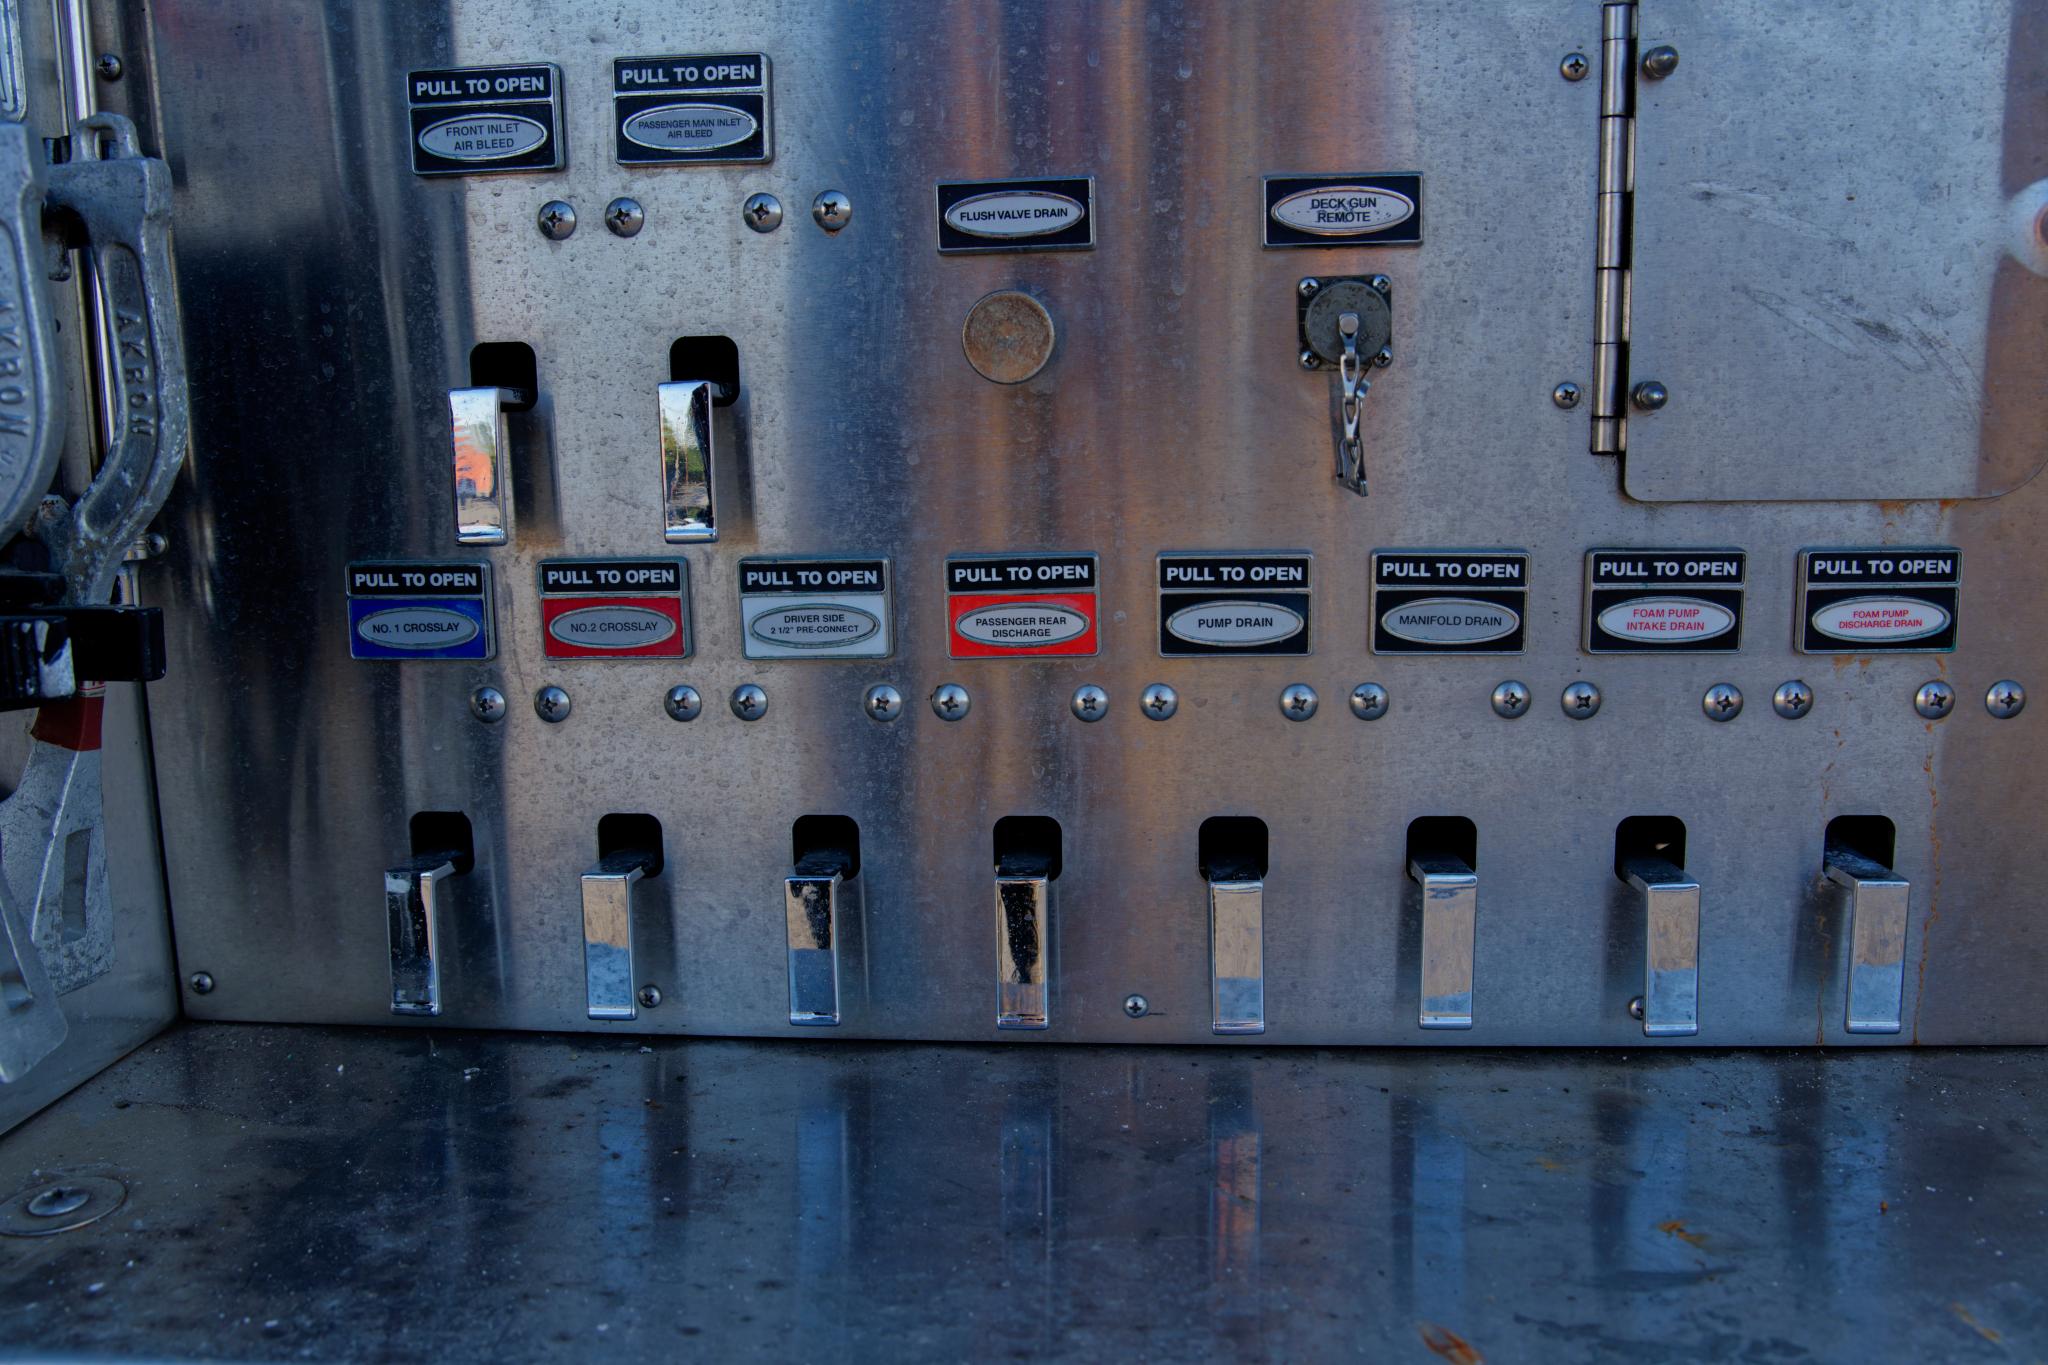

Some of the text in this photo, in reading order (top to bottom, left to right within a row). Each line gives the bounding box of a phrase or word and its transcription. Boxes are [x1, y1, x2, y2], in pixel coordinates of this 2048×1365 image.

[622, 64, 755, 84] PULL TO OPEN
[416, 76, 545, 96] PULL TO OPEN
[638, 118, 741, 129] PASSENGER MAIN INLET
[446, 123, 520, 137] FRONT INLET
[668, 129, 713, 139] AIR BLEED
[454, 138, 514, 151] AIR BLEED
[1311, 198, 1377, 209] DECK GUN
[960, 208, 1068, 221] FLUSH VALVE DRAIN
[1318, 211, 1371, 222] REMOTE
[1383, 563, 1519, 577] PULL TO OPEN
[1600, 562, 1737, 576] PULL TO OPEN
[1814, 560, 1951, 574] PULL TO OPEN
[548, 569, 674, 584] PULL TO OPEN
[747, 570, 877, 585] PULL TO OPEN
[955, 565, 1088, 582] PULL TO OPEN
[1166, 567, 1302, 581] PULL TO OPEN
[355, 573, 477, 587] PULL TO OPEN
[784, 614, 844, 623] DRIVER SIDE
[1633, 609, 1700, 618] FOAM PUMP
[1882, 610, 1909, 618] PUMP
[976, 617, 1066, 626] PASSENGER REAR
[1198, 618, 1272, 628] PUMP DRAIN
[1399, 616, 1502, 626] MANIFOLD DRAIN
[1627, 622, 1704, 631] INTAKE DRAIN
[1839, 619, 1922, 628] DISCHARGE DRAIN
[373, 624, 391, 633] NO.
[403, 623, 460, 632] CROSSLAY
[600, 622, 658, 632] CROSSLAY
[796, 625, 859, 633] PRE-CONNECT
[993, 629, 1051, 637] DISCHARGE
